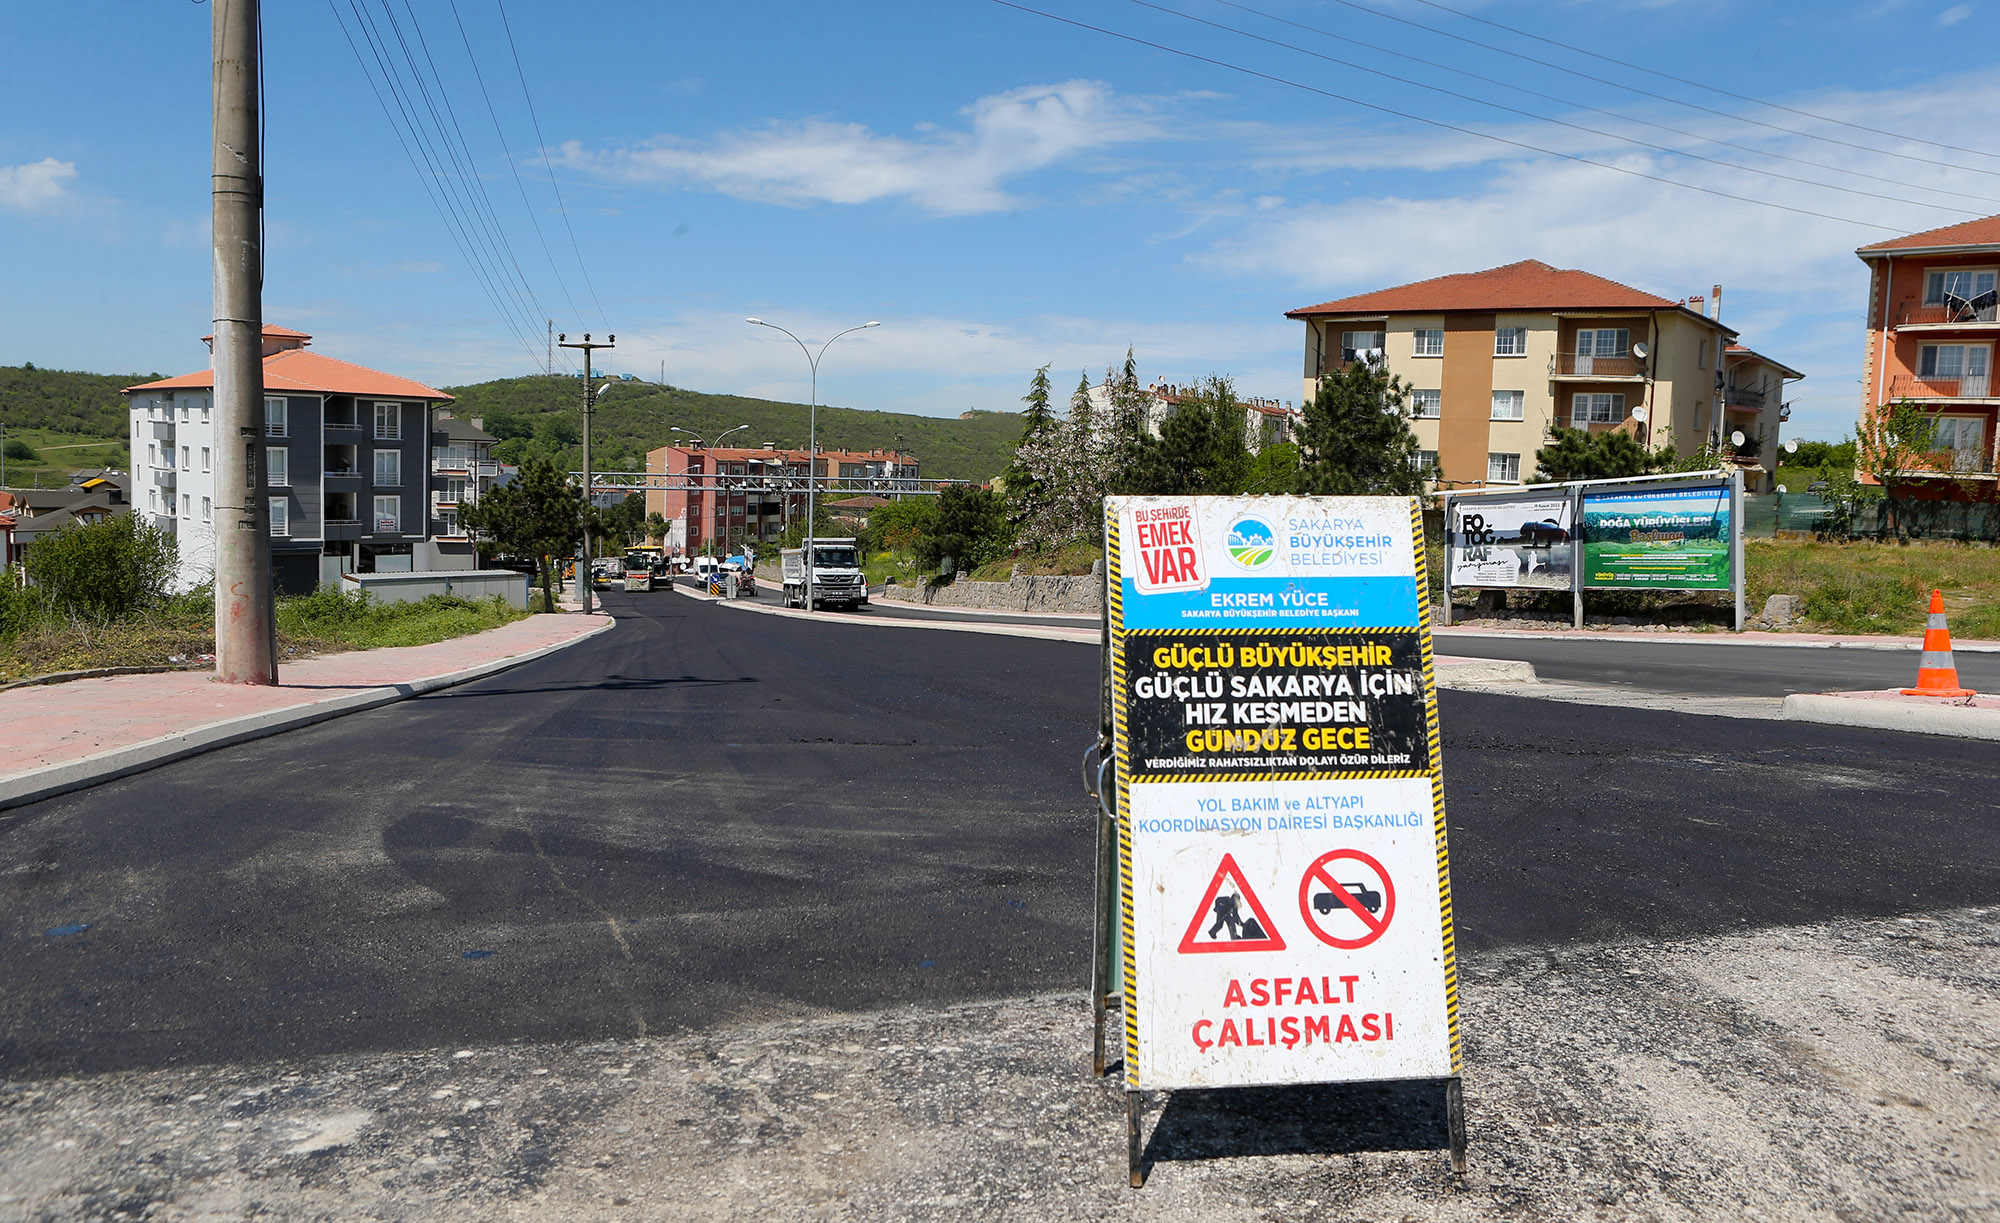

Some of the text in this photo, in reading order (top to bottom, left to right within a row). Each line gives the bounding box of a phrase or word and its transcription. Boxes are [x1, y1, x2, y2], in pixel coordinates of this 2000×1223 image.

[1135, 510, 1149, 522] BU
[1289, 518, 1364, 531] SAKARYA
[1462, 513, 1484, 532] FO
[1599, 516, 1632, 529] DOĞA
[1137, 520, 1194, 548] EMEK
[1290, 533, 1392, 549] BÜYÜKŞEHİR
[1462, 523, 1496, 545] TOĞ
[1291, 551, 1384, 566] BELEDİYESİ
[1462, 545, 1492, 561] RAF
[1141, 547, 1199, 584] VAR
[1211, 590, 1329, 608] EKREM YÜCE
[1181, 608, 1359, 619] SAKARYA BÜYÜKŞEHİR BELEDİYE BAŞKANI
[1153, 641, 1393, 671] GÜÇLÜ BÜYÜKŞEHİR
[1135, 669, 1413, 702] GÜÇLÜ SAKARYA İÇİN
[1185, 701, 1367, 725] HIZ KESMEDEN
[1186, 727, 1371, 753] GÜNDÜZ GECE
[1145, 753, 1411, 769] VERDİĞİMİZ RAHATSIZLIKTAN DOLAYI ÖZÜR DİLERİZ
[1197, 796, 1364, 812] YOL BAKIM ve ALTYAPI
[1139, 811, 1423, 833] KOORDİNASYON DAİRESİ BAŞKANLIĞI
[1223, 975, 1359, 1008] ASFALT
[1192, 1012, 1394, 1054] ÇALIŞMASI
